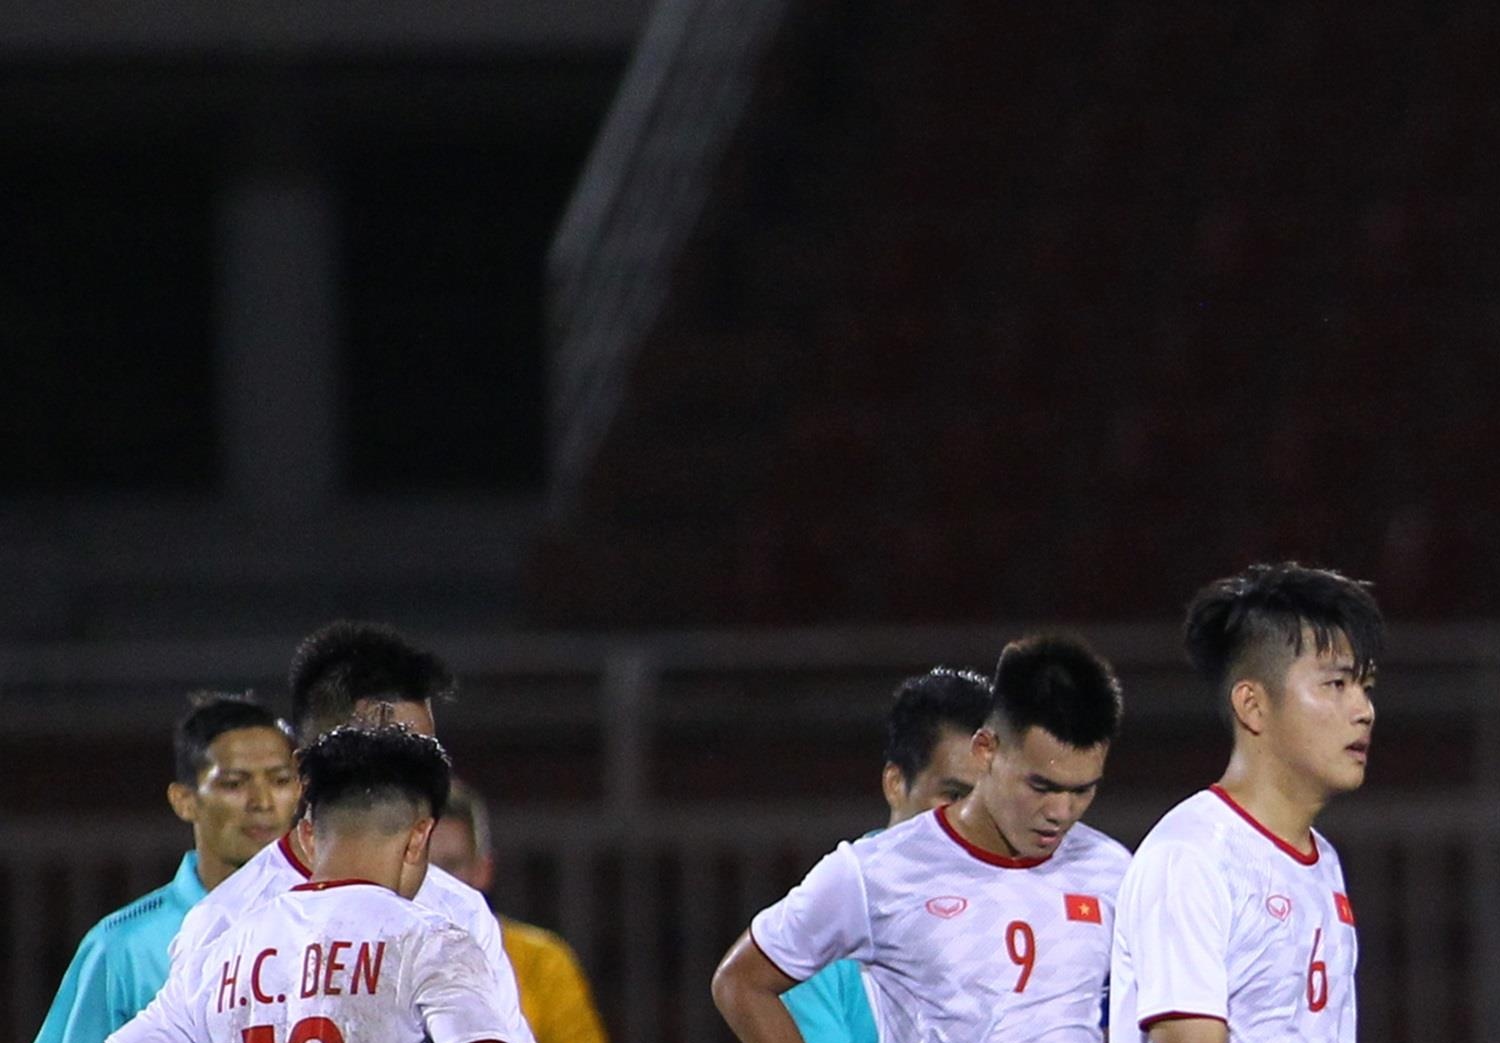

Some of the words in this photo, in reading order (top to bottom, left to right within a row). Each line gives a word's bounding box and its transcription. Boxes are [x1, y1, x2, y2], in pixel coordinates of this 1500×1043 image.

[217, 947, 286, 1013] H.C.
[300, 940, 386, 1000] DEN
[1004, 919, 1037, 994] 9
[1307, 928, 1329, 1014] 6
